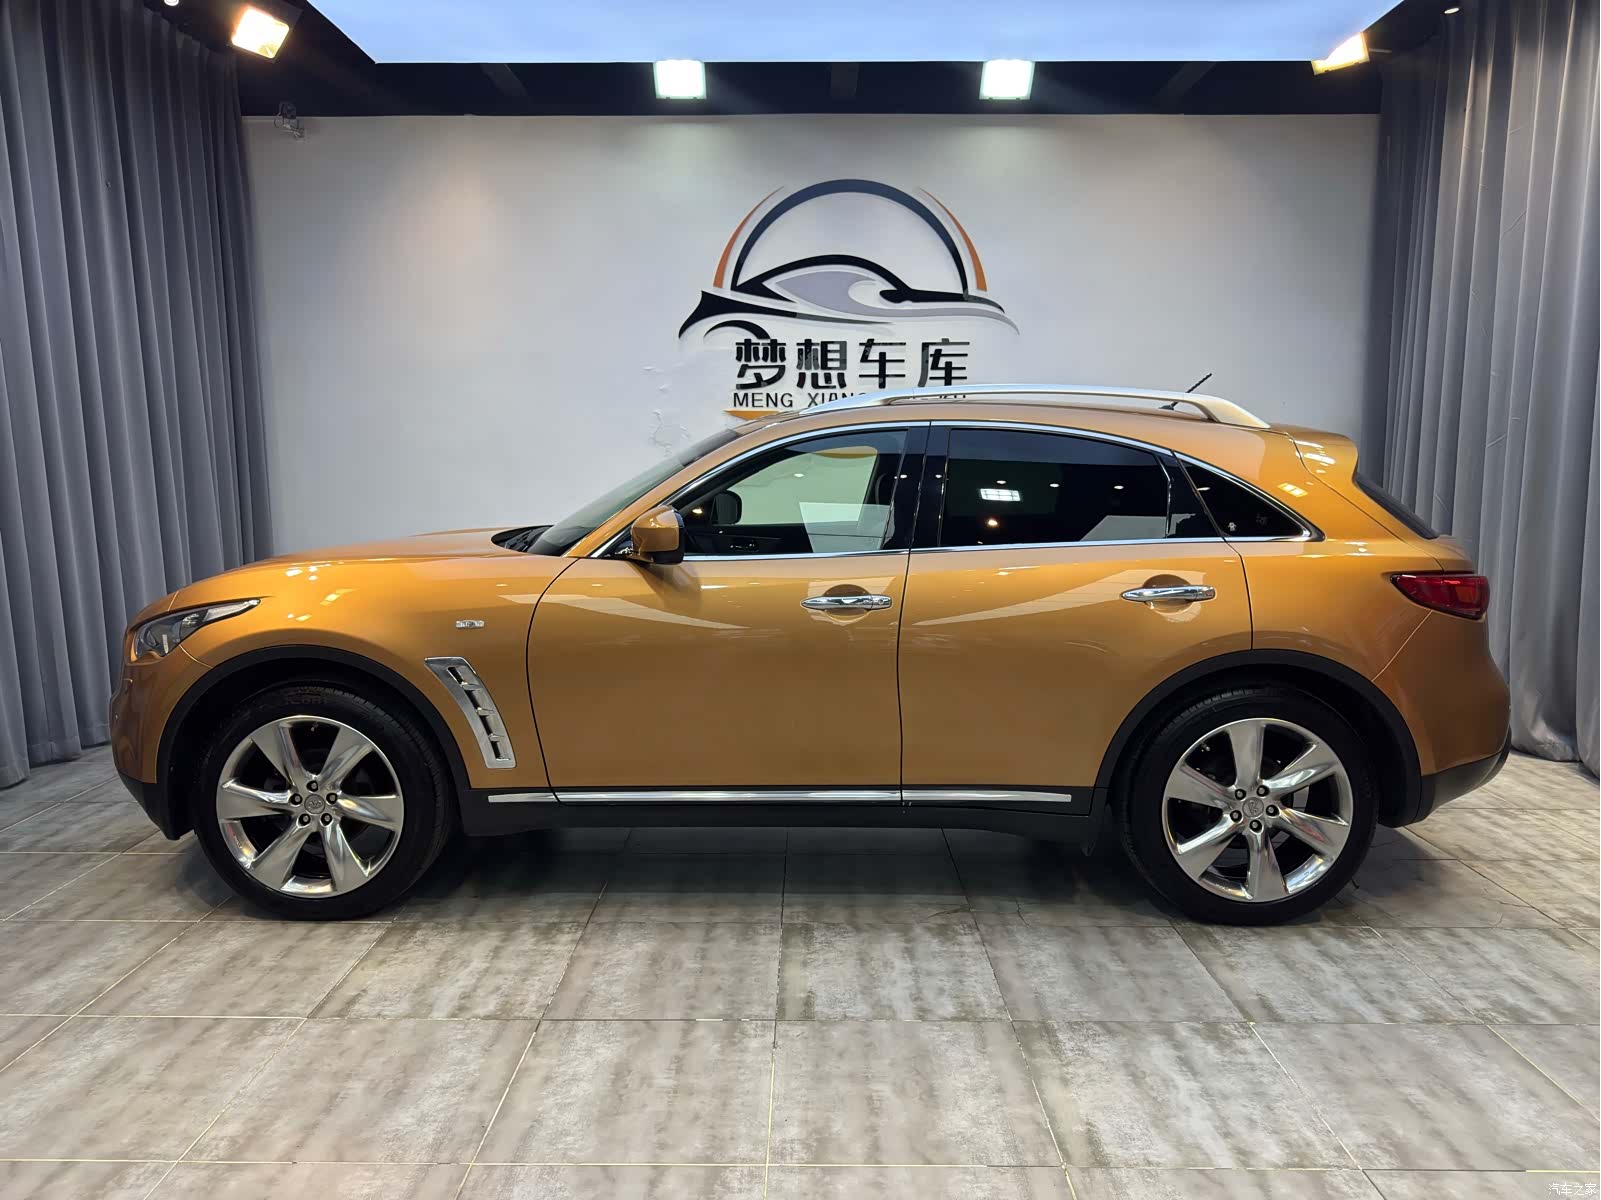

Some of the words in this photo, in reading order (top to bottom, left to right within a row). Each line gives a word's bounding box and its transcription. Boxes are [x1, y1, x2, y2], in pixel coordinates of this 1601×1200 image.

[735, 338, 970, 389] 梦想车库
[733, 392, 793, 408] MENG
[808, 392, 867, 408] XIA
